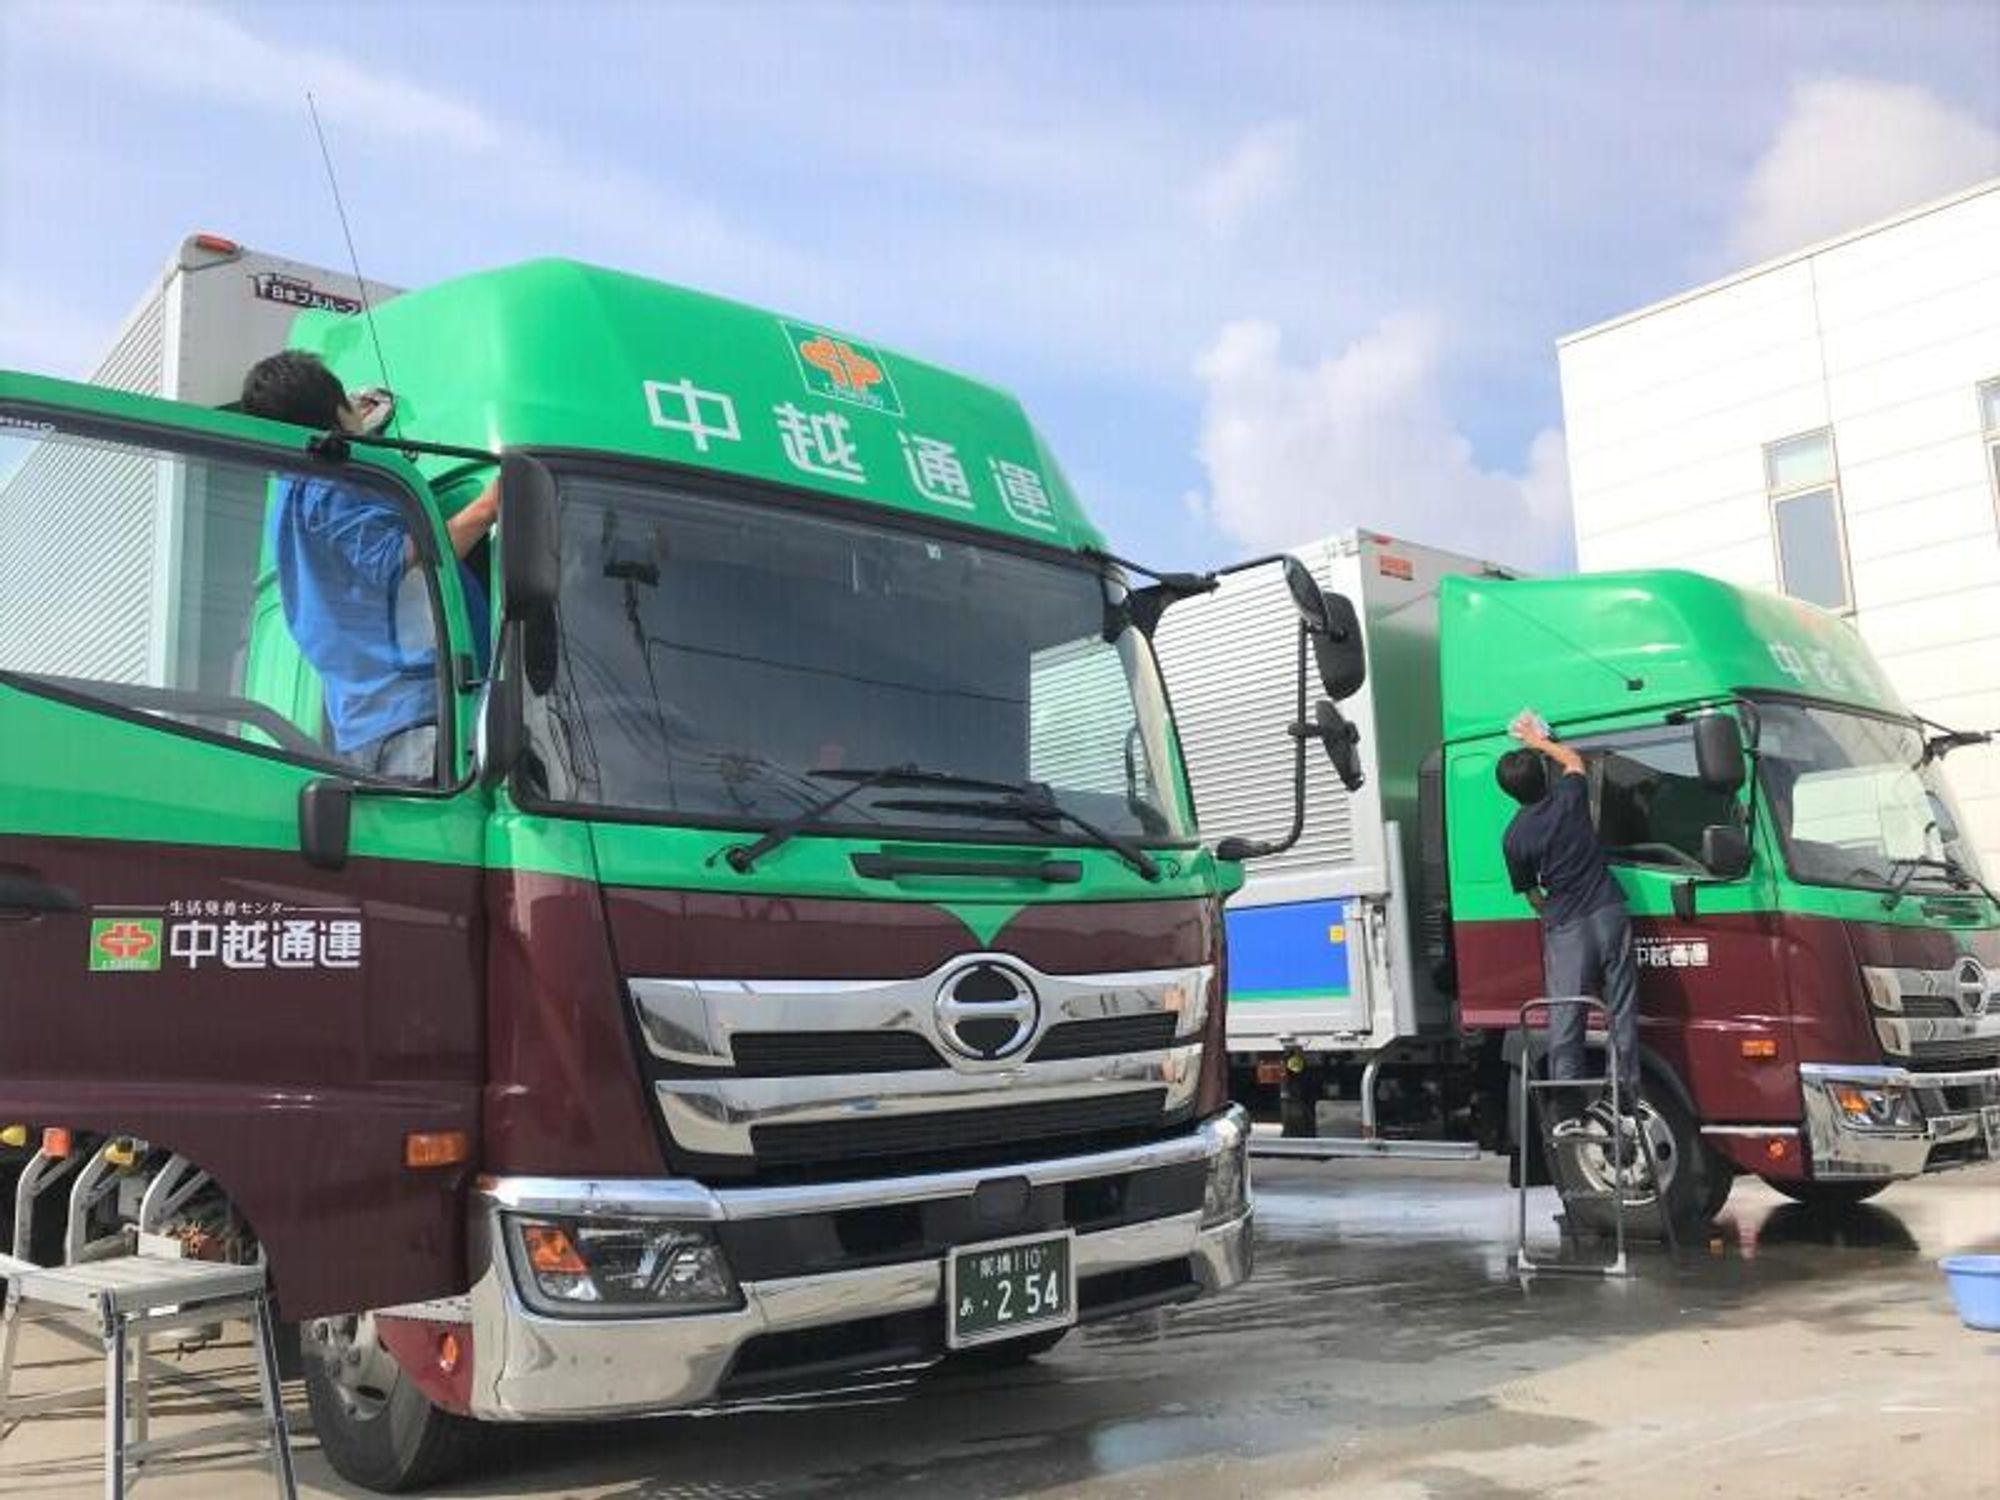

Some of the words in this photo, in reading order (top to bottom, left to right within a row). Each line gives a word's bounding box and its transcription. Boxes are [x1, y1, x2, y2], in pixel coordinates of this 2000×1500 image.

[643, 378, 1057, 532] 中越通運
[170, 920, 361, 969] 中越通運
